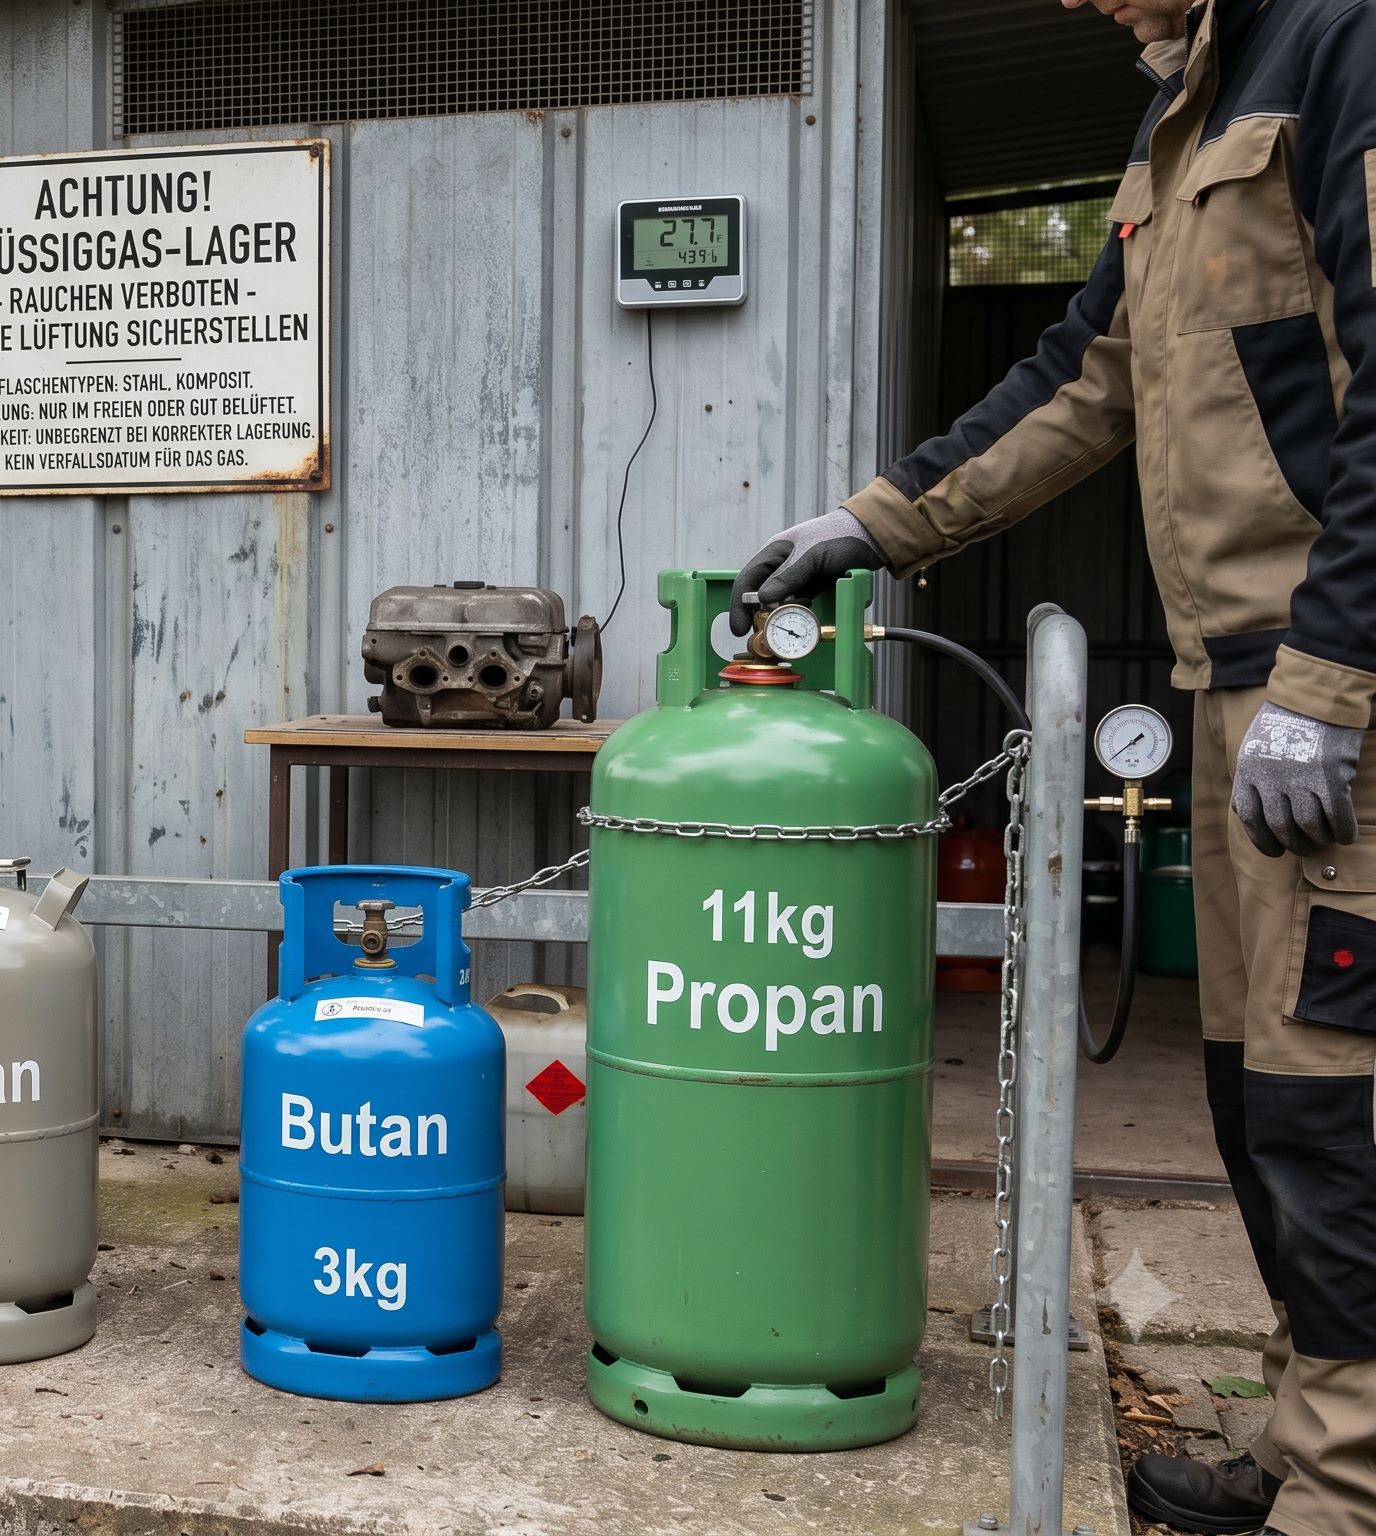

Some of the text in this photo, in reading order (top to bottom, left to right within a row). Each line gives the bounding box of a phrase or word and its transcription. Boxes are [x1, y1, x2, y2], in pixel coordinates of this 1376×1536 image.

[34, 170, 211, 220] ACHTUNG!
[660, 217, 715, 247] 27.7
[10, 283, 113, 315] RAUCHEN
[120, 278, 239, 310] VERBOTEN
[20, 318, 119, 351] LÜFTUNG
[126, 313, 308, 347] SICHERSTELLEN
[123, 373, 172, 392] STAHL,
[176, 370, 253, 391] KOMPOSIT.
[39, 402, 68, 420] NUR
[72, 401, 89, 419] IM
[93, 400, 143, 419] FREIEN
[147, 399, 185, 417] ODER
[190, 398, 218, 417] GUT
[222, 392, 298, 416] BELÜFTET.
[35, 426, 123, 445] UNBEGRENZT
[126, 425, 147, 443] BEI
[152, 423, 232, 442] KORREKTER
[237, 421, 315, 441] LAGERUNG.
[5, 446, 248, 471] KEIN VERFALLSDATUM FÜR DAS GAS.
[702, 889, 834, 959] 11kg
[647, 959, 883, 1052] Propan
[281, 1092, 447, 1157] Butan
[313, 1246, 407, 1311] 3kg
